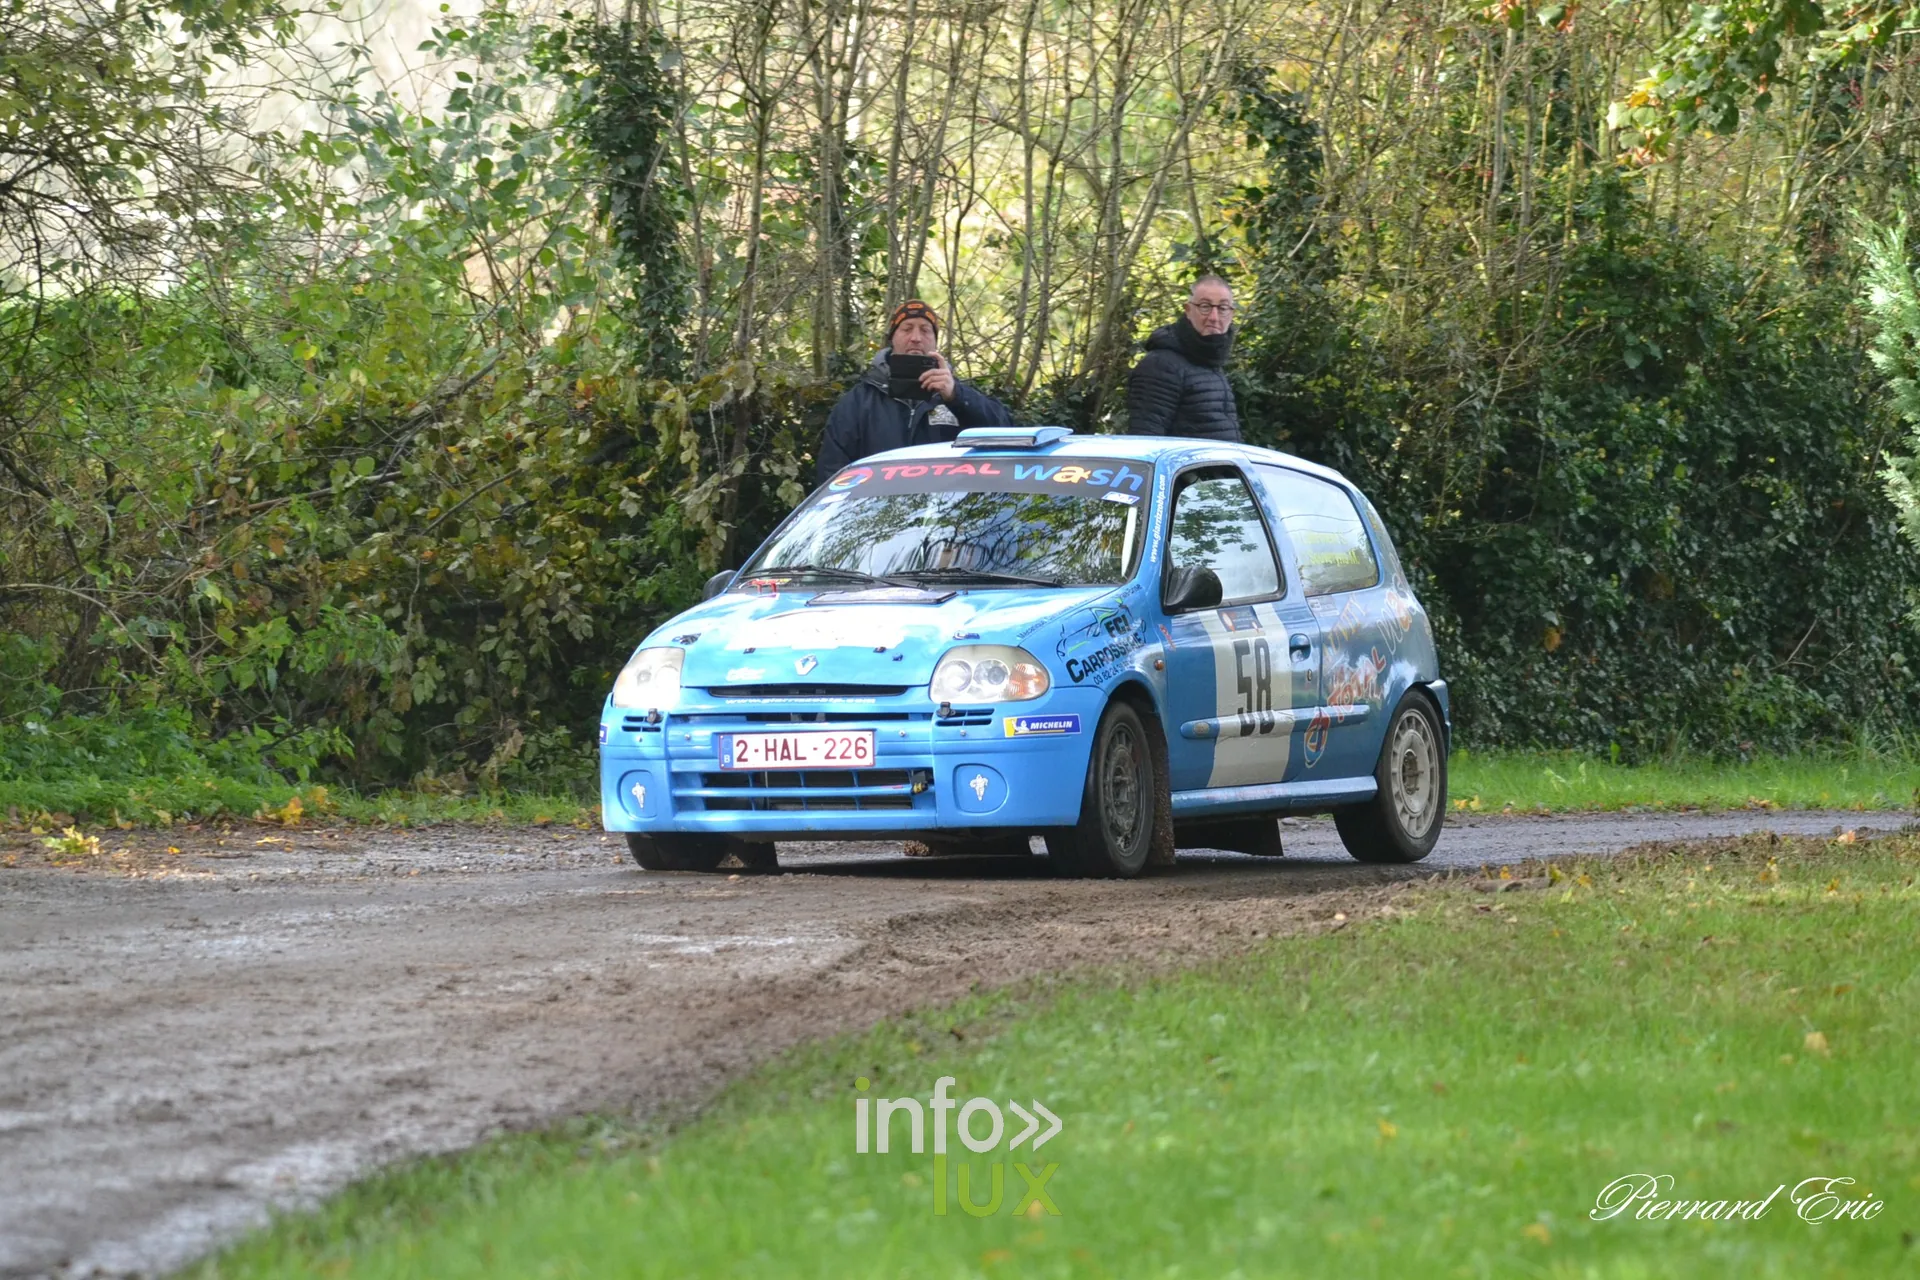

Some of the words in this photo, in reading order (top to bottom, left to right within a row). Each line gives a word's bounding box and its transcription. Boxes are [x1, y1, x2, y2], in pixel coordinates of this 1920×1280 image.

[881, 462, 1001, 482] TOTAL
[1014, 463, 1145, 492] Wash
[1104, 614, 1131, 638] FCI
[1234, 638, 1276, 738] 58
[1326, 646, 1386, 724] TOTAL
[1030, 720, 1073, 730] MICHELIN
[724, 755, 731, 763] B
